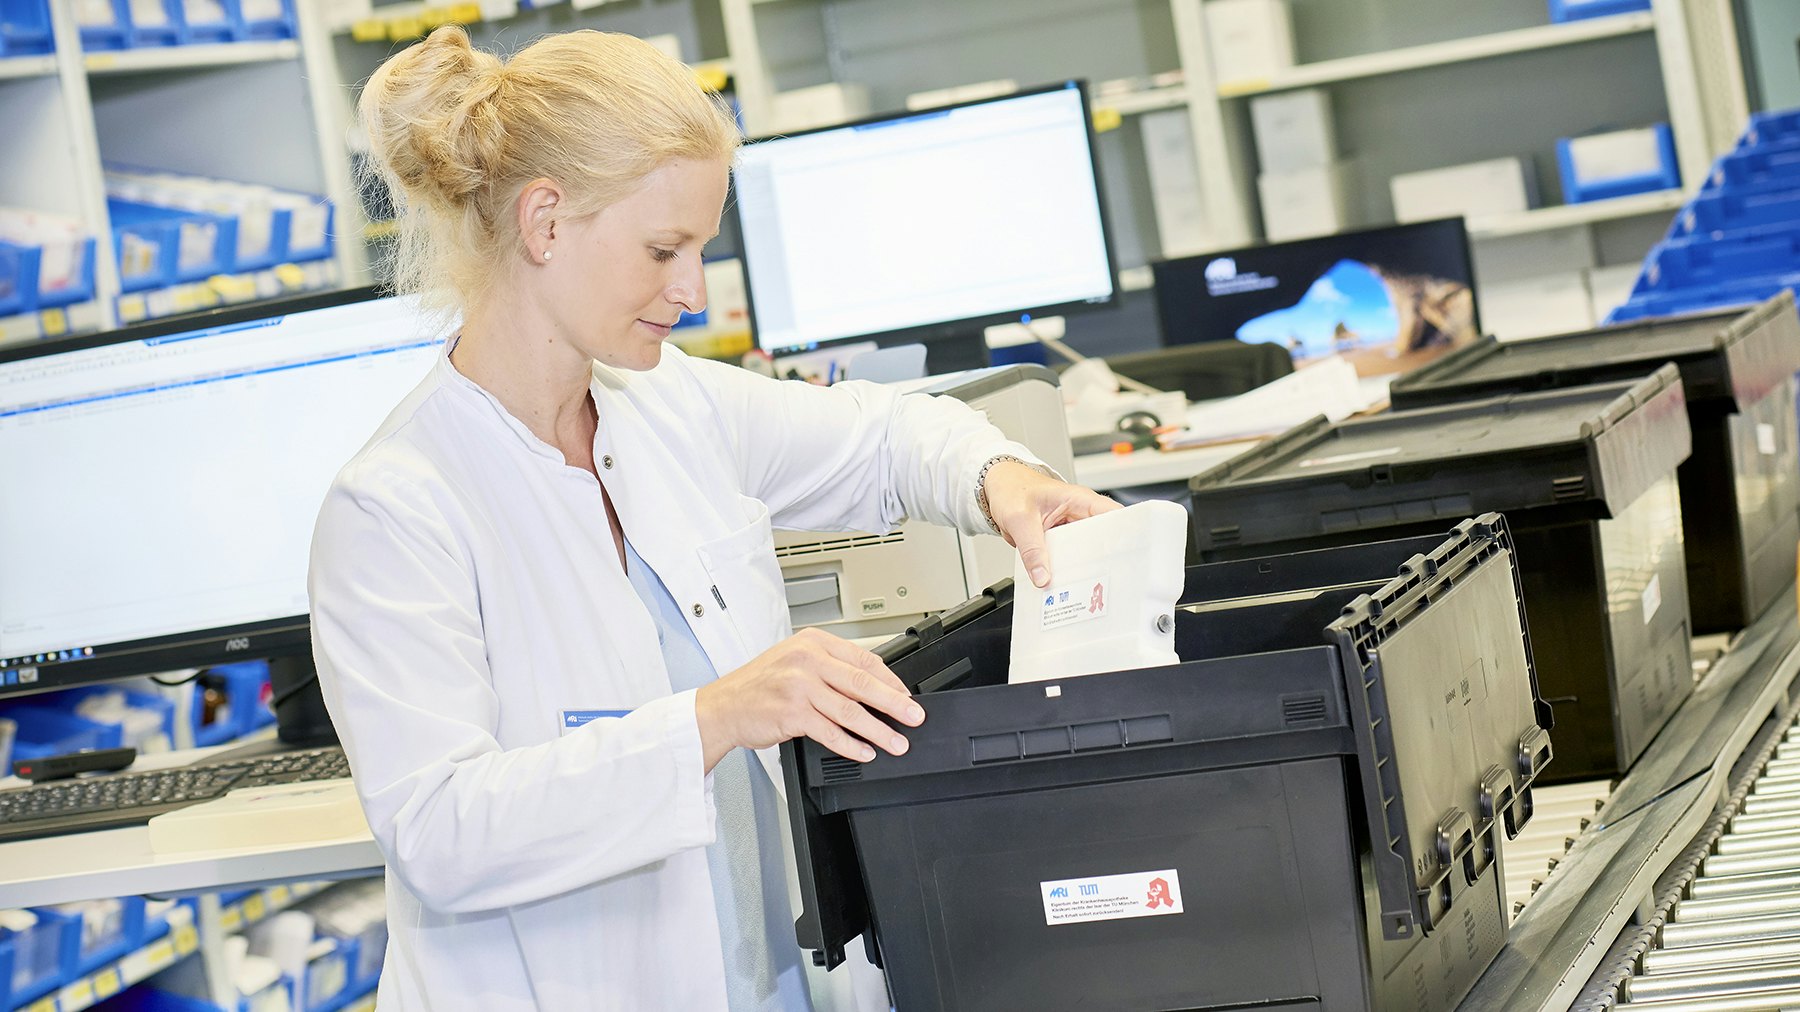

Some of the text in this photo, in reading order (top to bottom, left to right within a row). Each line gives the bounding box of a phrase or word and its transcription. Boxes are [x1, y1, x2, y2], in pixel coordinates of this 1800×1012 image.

[863, 603, 884, 611] PUSH
[225, 637, 250, 651] AOC
[1049, 887, 1068, 898] MRI
